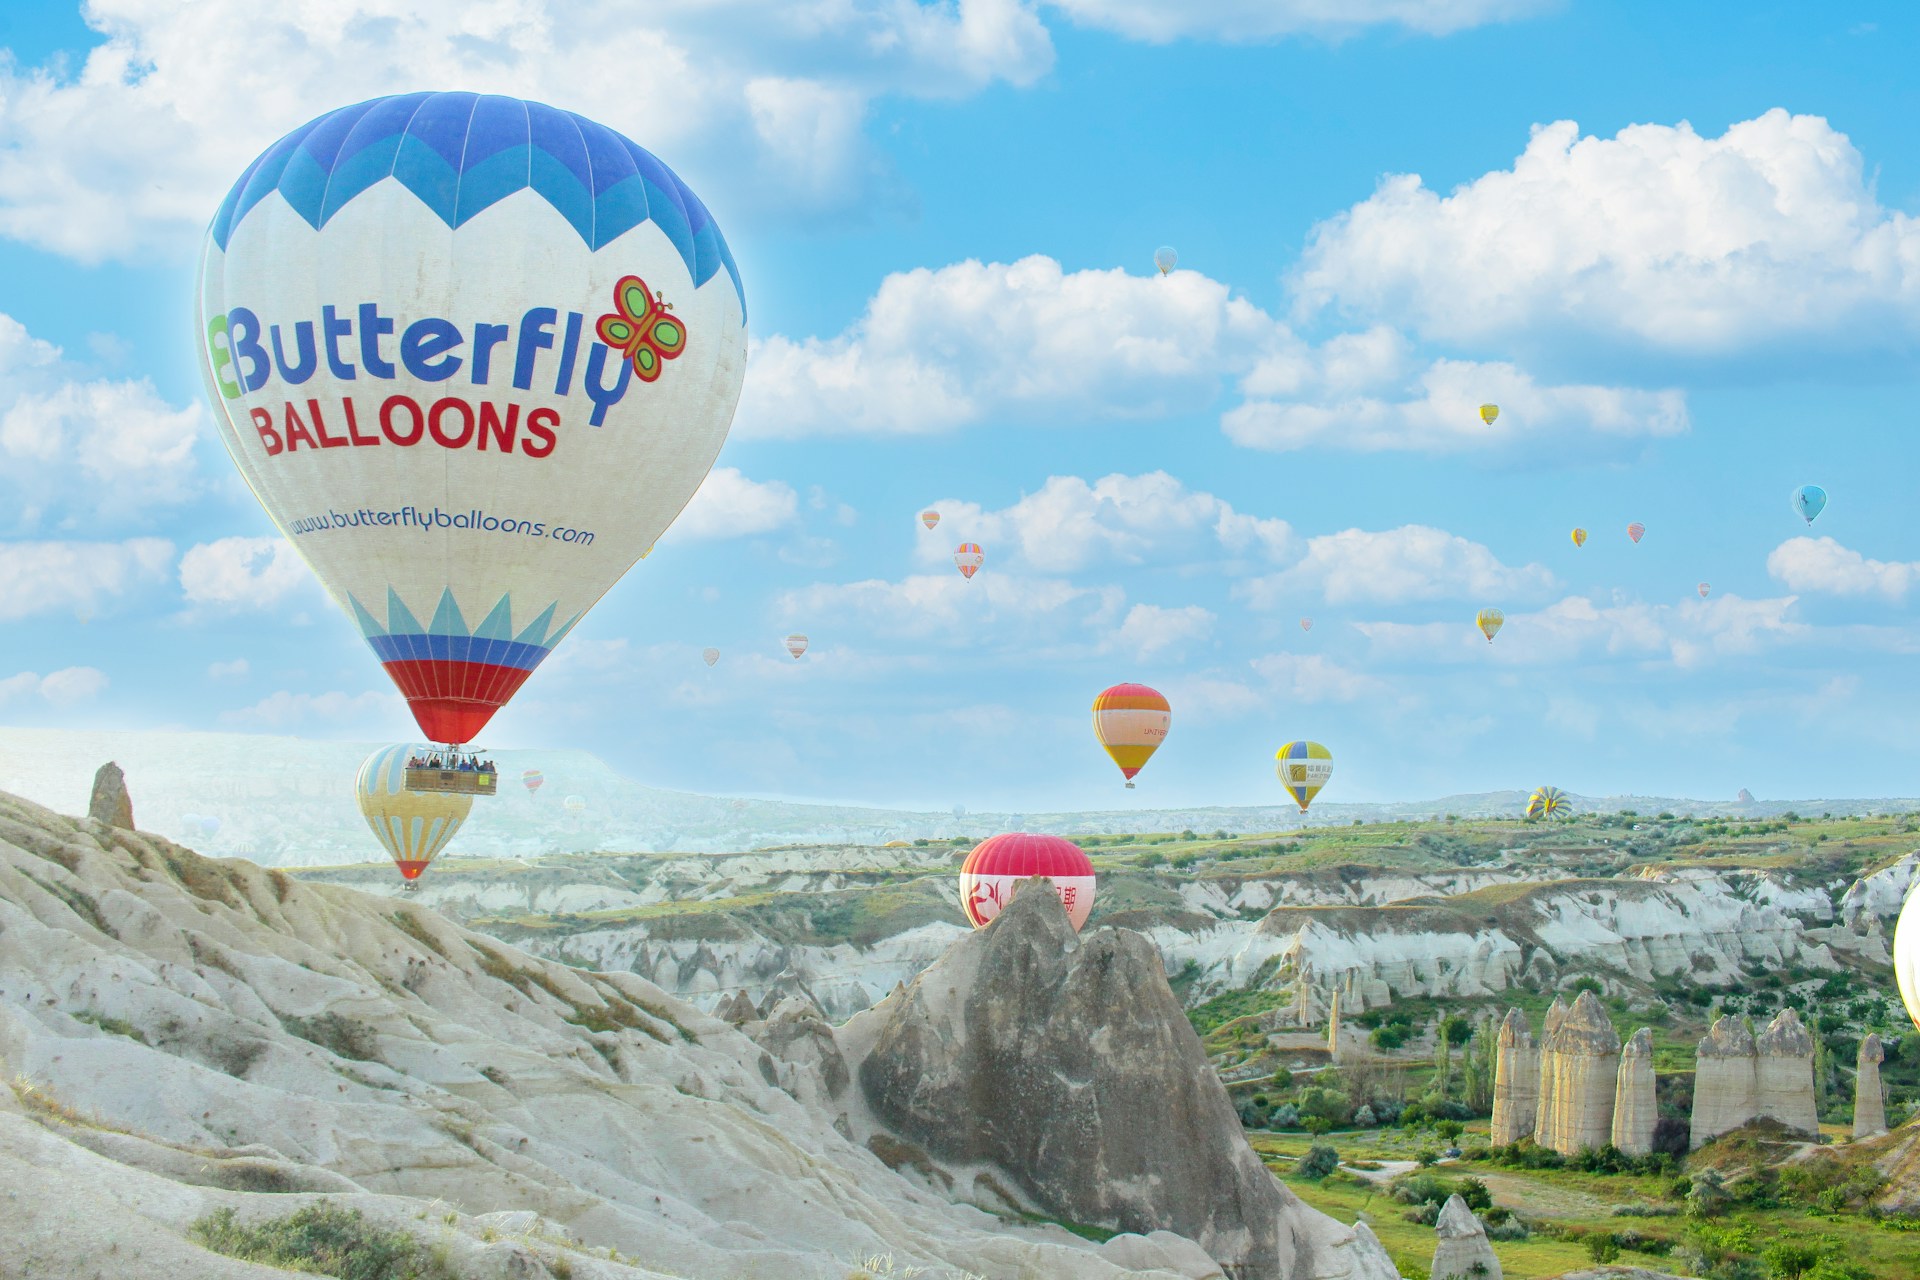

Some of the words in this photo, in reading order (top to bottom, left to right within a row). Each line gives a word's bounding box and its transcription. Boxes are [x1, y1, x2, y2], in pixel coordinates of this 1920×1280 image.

[226, 303, 634, 428] Butterfly
[249, 394, 561, 459] BALLOONS
[289, 506, 595, 546] www.butterflyballoons.com
